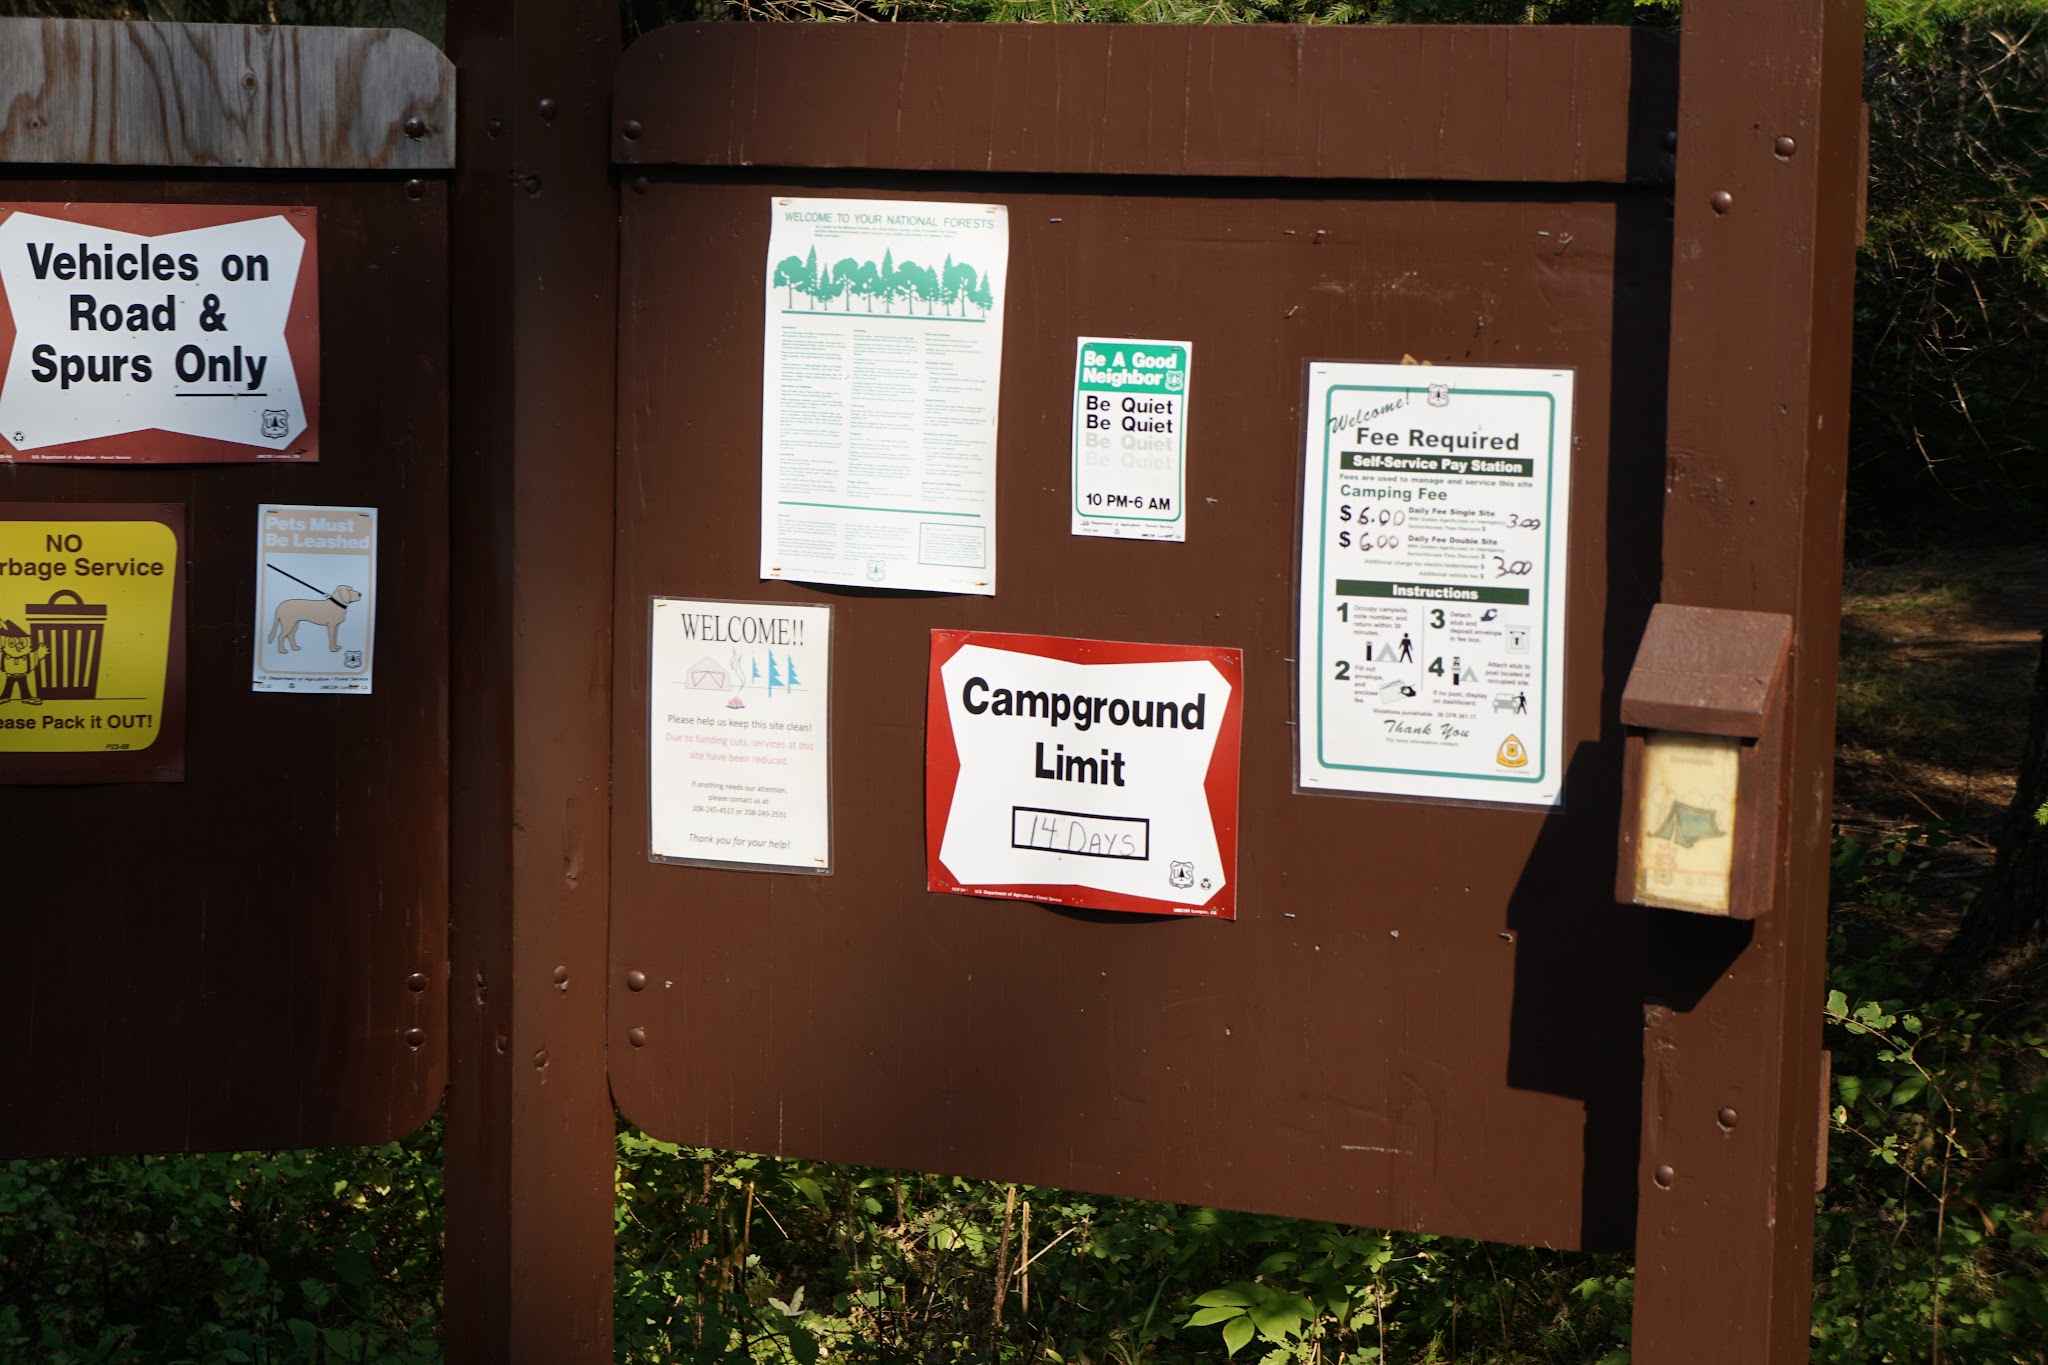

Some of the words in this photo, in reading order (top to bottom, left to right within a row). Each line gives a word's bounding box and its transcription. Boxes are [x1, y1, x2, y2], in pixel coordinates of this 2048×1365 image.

[785, 212, 832, 222] WELCOME
[837, 213, 850, 223] TO
[855, 214, 882, 224] YOUR
[887, 216, 938, 226] NATIONAL
[944, 218, 994, 229] FORESTS
[27, 243, 198, 281] Vehicles
[222, 255, 268, 281] on
[70, 295, 176, 332] Road
[200, 294, 228, 332] &
[32, 344, 152, 390] Spurs
[176, 345, 267, 390] Only
[1084, 351, 1106, 366] Be
[1112, 352, 1126, 367] A
[1132, 352, 1177, 369] Good
[1083, 367, 1164, 387] Neighbor
[1087, 396, 1110, 411] Be
[1122, 397, 1172, 414] Quiet
[1328, 388, 1409, 434] Welcome!
[1087, 414, 1110, 430] Be
[1122, 416, 1172, 433] Quiet
[1086, 433, 1110, 448] Be
[1121, 434, 1172, 452] Quiet
[1357, 428, 1398, 446] Fee
[1410, 429, 1518, 452] Required
[1353, 455, 1438, 470] Self-Service
[1442, 458, 1468, 473] Pay
[1471, 460, 1522, 473] Station
[1087, 494, 1102, 506] 10
[1108, 495, 1142, 508] PM-6
[1149, 498, 1170, 510] AM
[1341, 484, 1412, 502] Camping
[1419, 488, 1447, 500] Fee
[1340, 504, 1352, 522] $
[1357, 506, 1406, 526] 6.00
[1409, 507, 1429, 515] Daily
[1450, 509, 1476, 517] Single
[266, 517, 306, 531] Pets
[310, 518, 354, 532] Must
[47, 534, 82, 552] NO
[265, 533, 288, 547] Be
[293, 534, 371, 549] Leashed
[1339, 530, 1350, 549] $
[1409, 535, 1428, 543] Daily
[0, 558, 66, 581] rbage
[75, 558, 164, 576] Service
[1393, 584, 1478, 600] Instructions
[1338, 603, 1348, 622] 1
[1430, 609, 1445, 629] 3
[682, 614, 803, 646] WELCOME!!
[1335, 661, 1350, 680] 2
[1429, 657, 1444, 677] 4
[963, 677, 1205, 731] Campground
[0, 719, 36, 729] ease
[43, 716, 85, 729] Pack
[91, 716, 102, 728] it
[108, 715, 152, 728] OUT!
[668, 715, 694, 724] Please
[697, 716, 715, 727] help
[729, 719, 749, 729] keep
[752, 720, 767, 729] this
[787, 723, 812, 732] clean!
[1384, 720, 1431, 735] Thank
[1441, 723, 1469, 740] You
[666, 733, 682, 742] Due
[696, 734, 728, 747] funding
[752, 739, 786, 749] services
[799, 742, 814, 751] this
[690, 752, 705, 760] site
[707, 752, 727, 761] have
[729, 754, 750, 762] been
[1036, 742, 1125, 786] Limit
[697, 782, 724, 790] anything
[689, 834, 714, 843] Thank
[732, 836, 746, 847] for
[748, 840, 767, 848] your
[769, 840, 790, 850] help!
[1030, 815, 1057, 849] 14
[1067, 821, 1136, 857] DAYS
